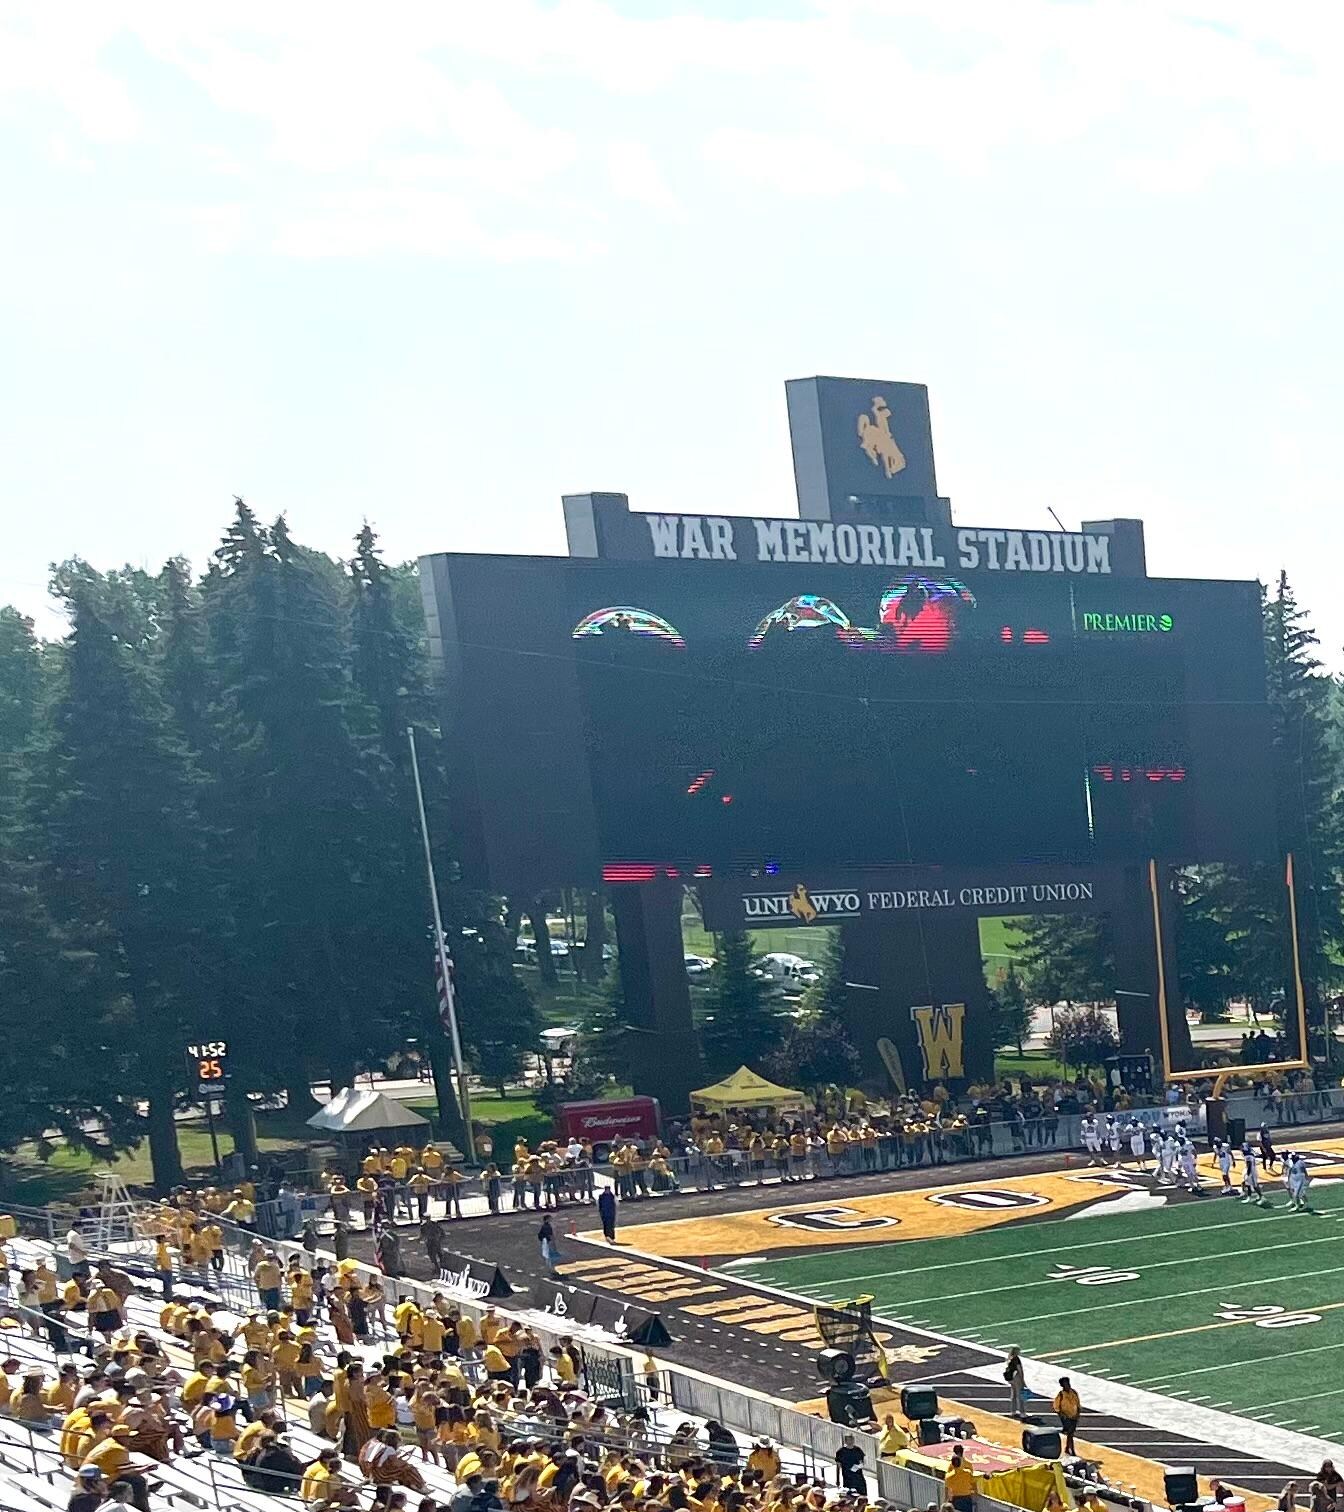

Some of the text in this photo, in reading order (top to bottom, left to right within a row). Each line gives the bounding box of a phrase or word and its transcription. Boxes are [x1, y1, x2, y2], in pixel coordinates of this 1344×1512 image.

[645, 515, 1112, 574] WAR MEMORIAL STADIUM
[1083, 613, 1158, 632] PREMIER
[867, 890, 955, 910] FEDERAL
[959, 886, 1028, 906] CREDIT
[1032, 882, 1094, 902] UNION
[910, 1003, 965, 1081] W
[198, 1060, 222, 1079] 25
[581, 1116, 643, 1129] Budweiser
[1046, 1266, 1141, 1285] 10
[1213, 1305, 1322, 1328] 20
